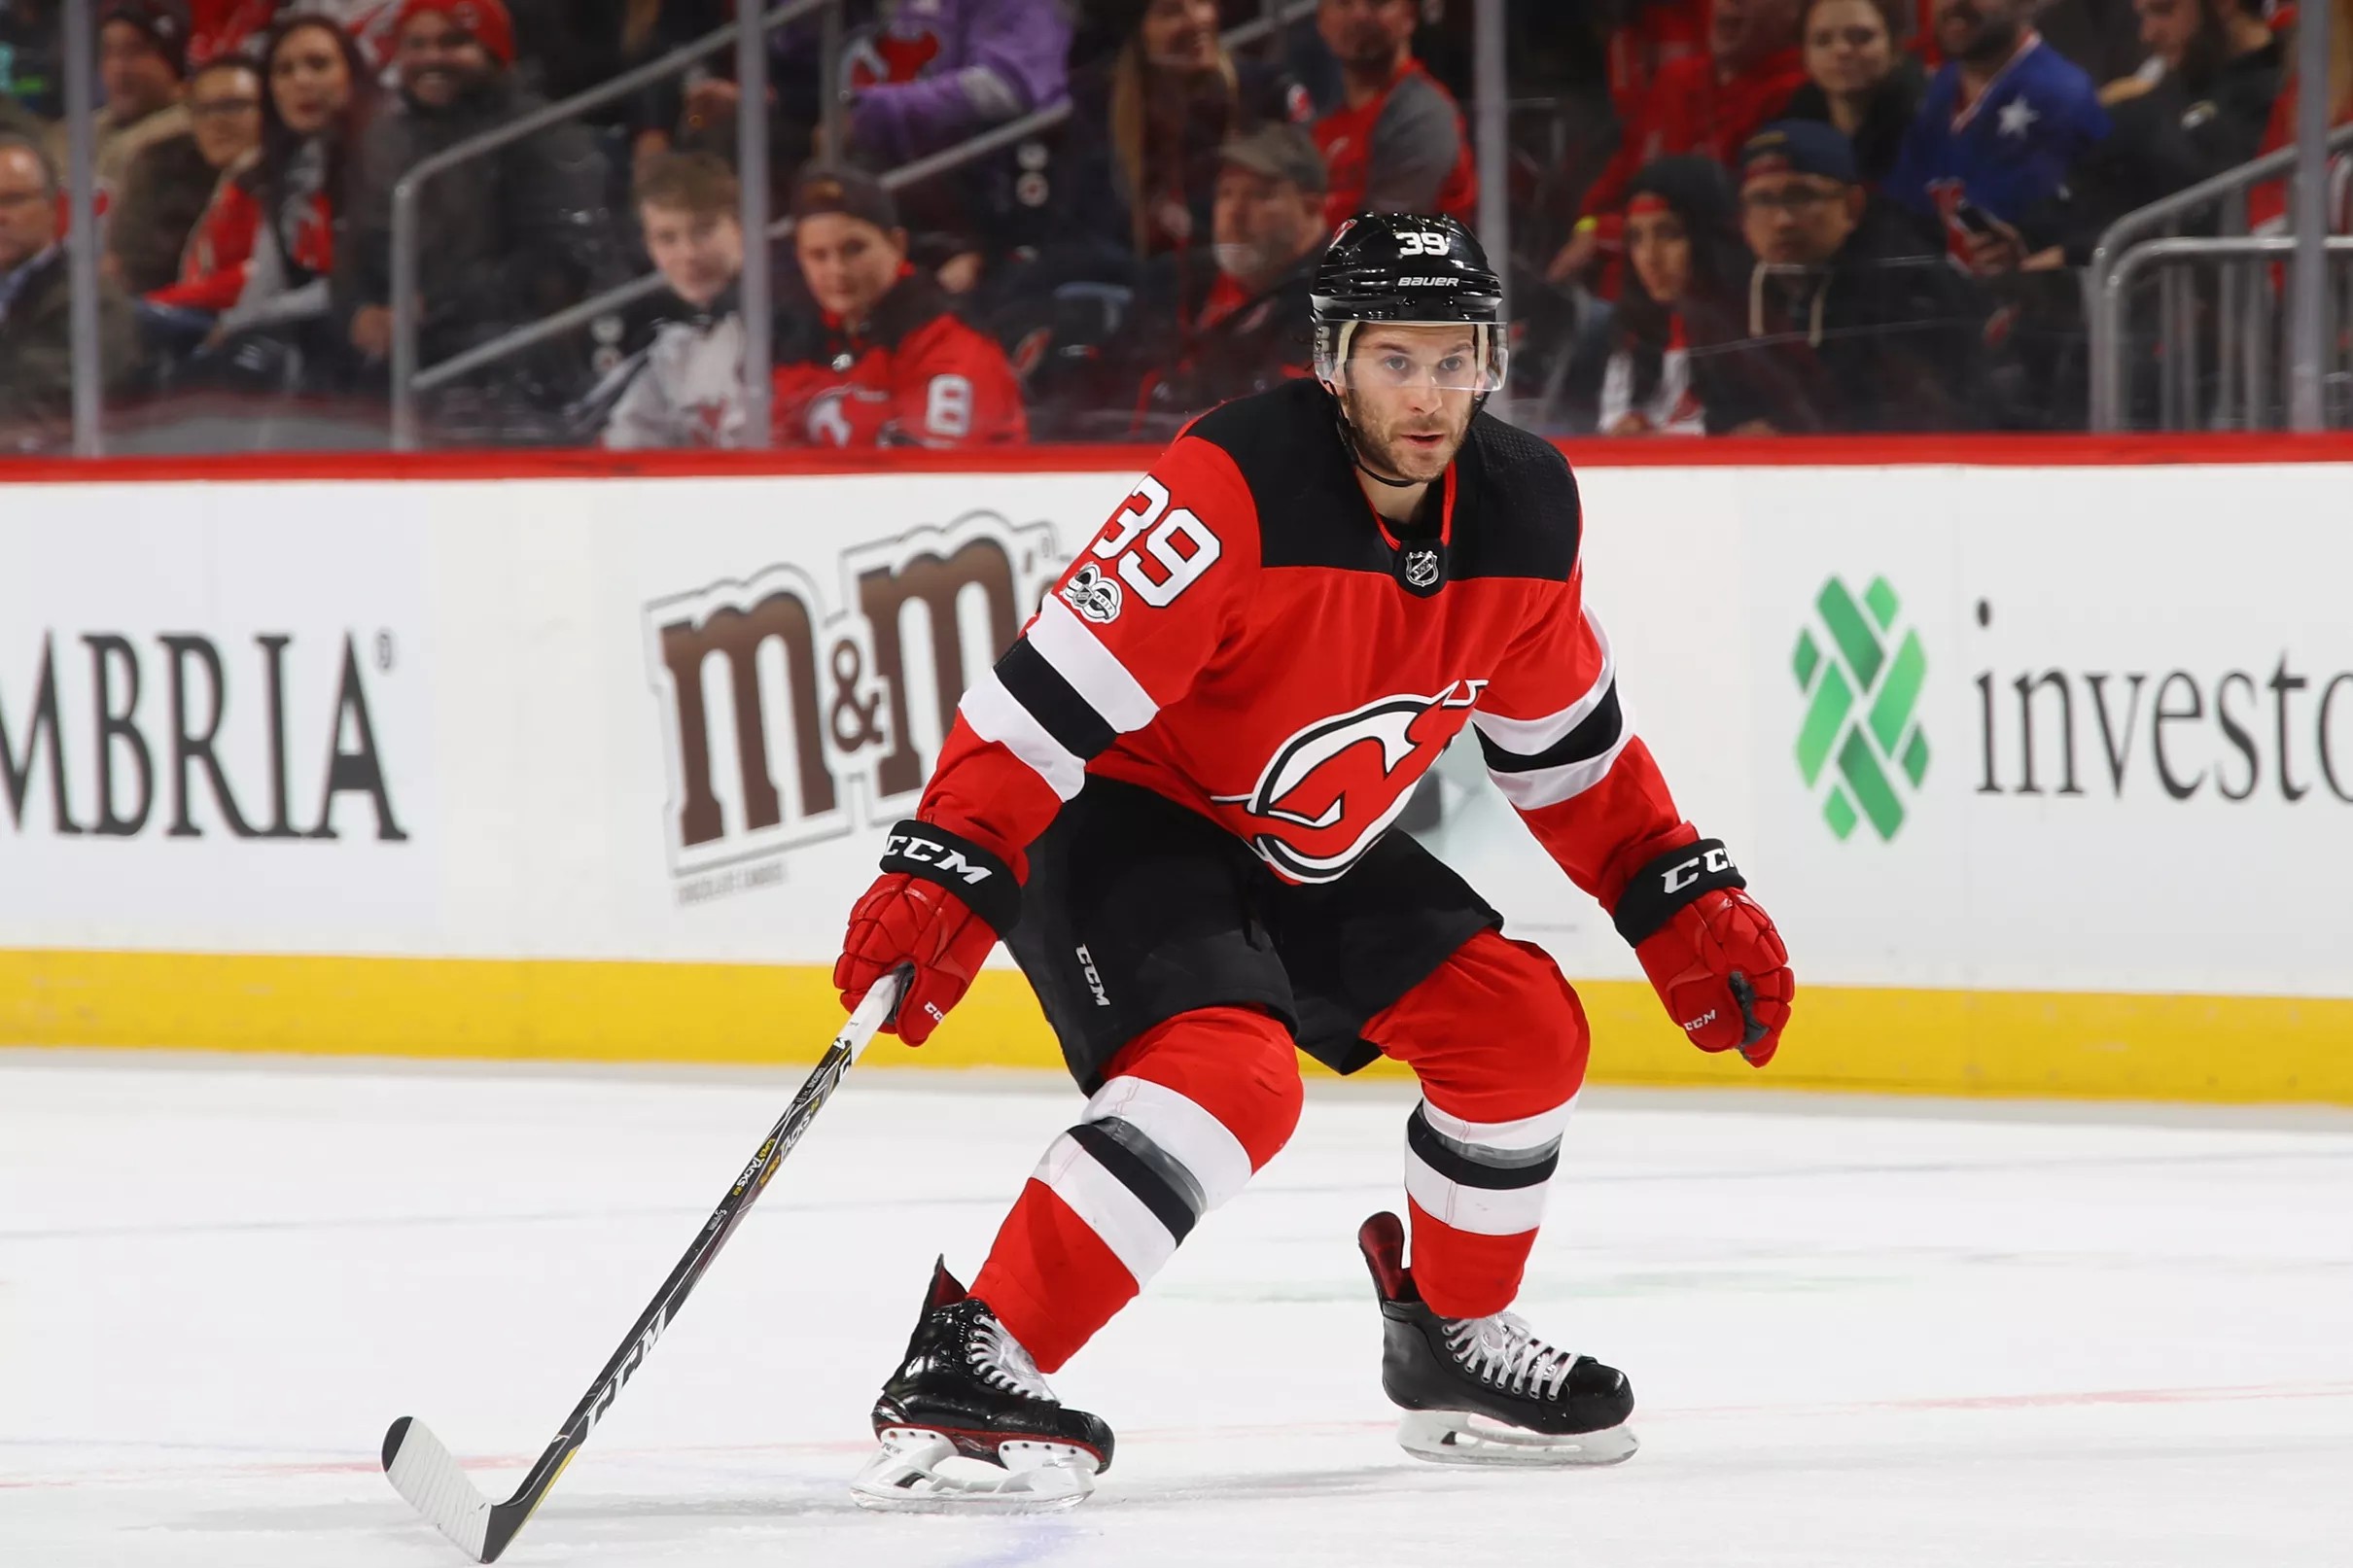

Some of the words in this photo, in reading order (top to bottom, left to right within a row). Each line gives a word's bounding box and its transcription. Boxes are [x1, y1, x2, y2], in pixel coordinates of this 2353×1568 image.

[1395, 231, 1451, 257] 39
[1397, 277, 1459, 288] BAUER
[1091, 473, 1223, 609] 39
[884, 835, 993, 885] CCM
[1661, 848, 1736, 894] CC
[1075, 943, 1110, 1006] CCM
[1684, 1009, 1716, 1030] CCM
